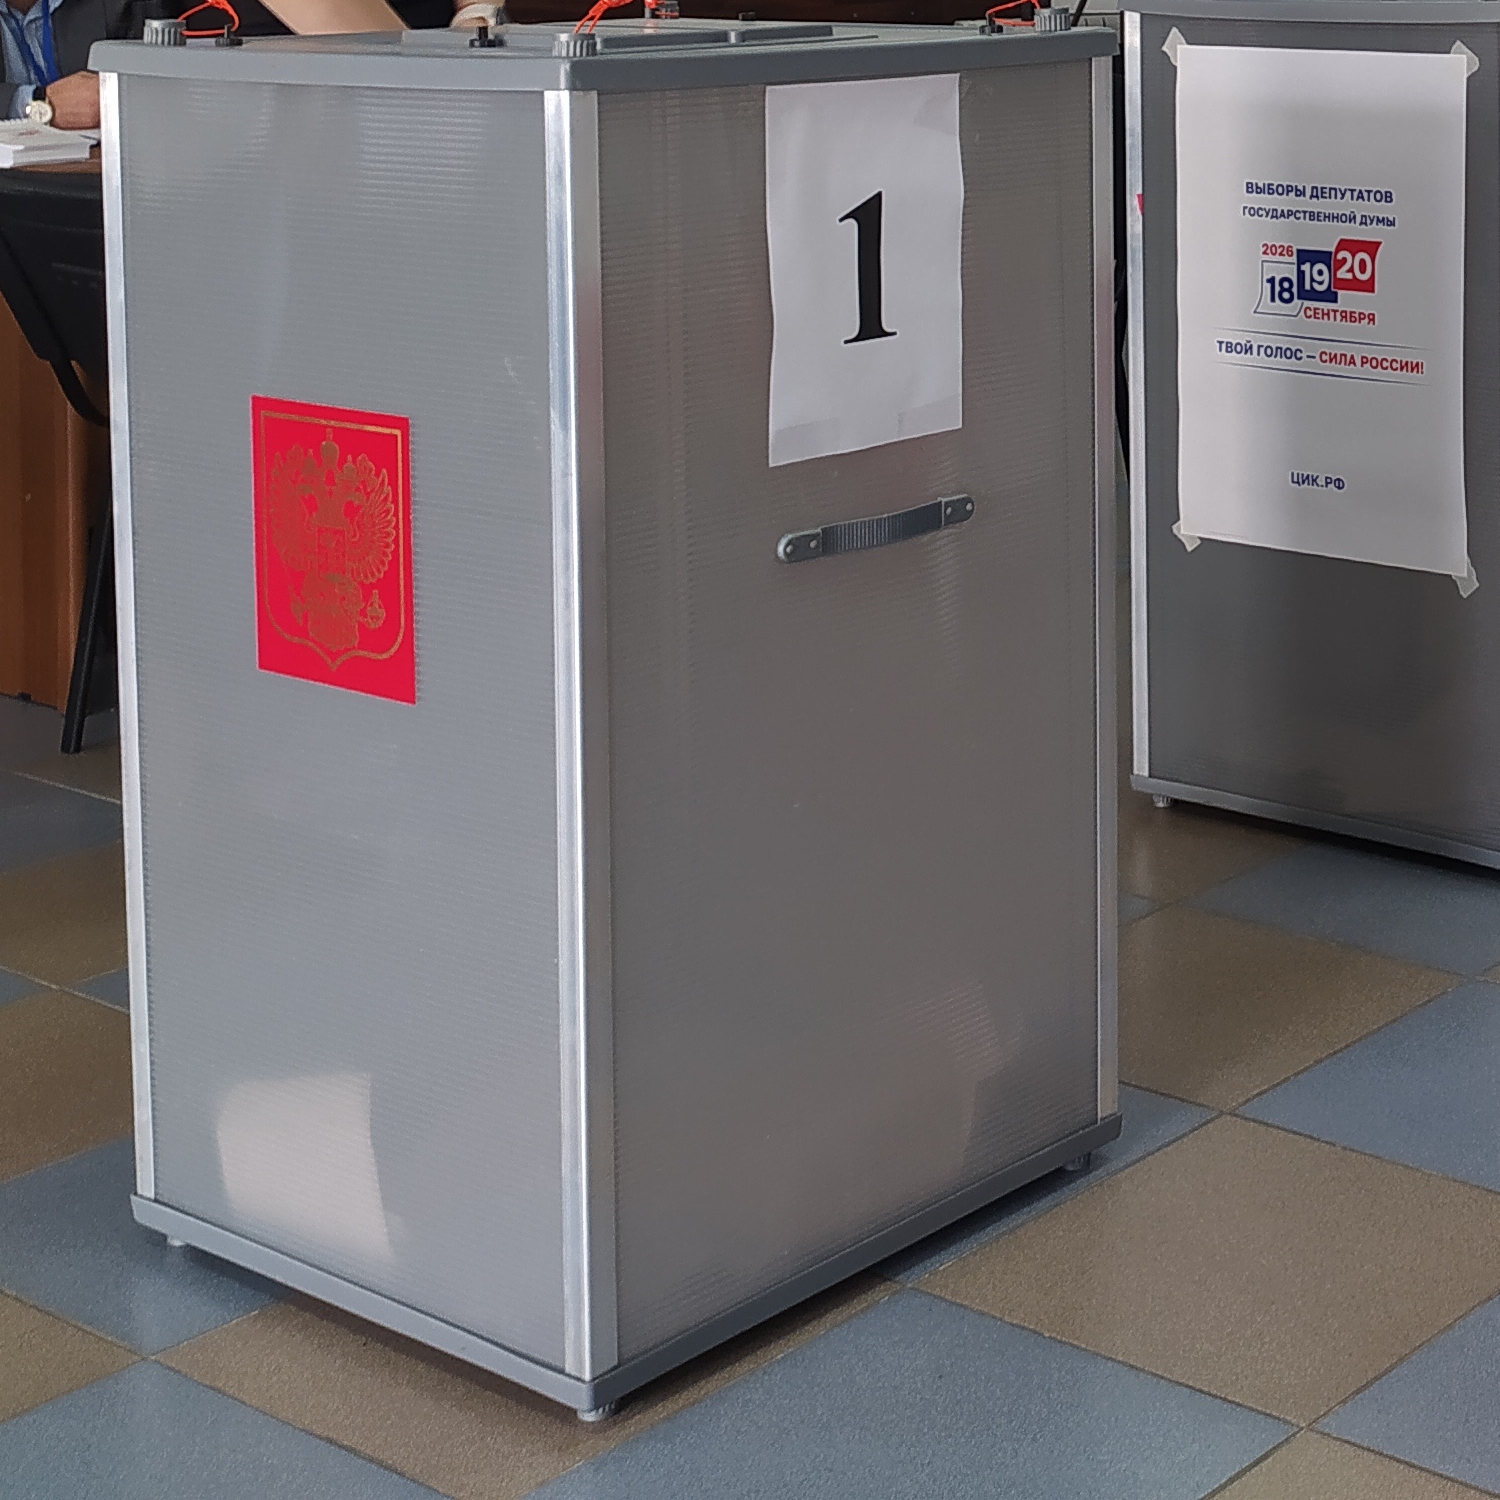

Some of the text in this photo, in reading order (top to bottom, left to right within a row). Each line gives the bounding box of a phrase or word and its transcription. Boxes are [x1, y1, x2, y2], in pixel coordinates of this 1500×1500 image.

[1245, 181, 1394, 204] ВЫБОРЫ ДЕПУТАТОВ
[1242, 205, 1396, 228] ГОСУДАРСТВЕННОЙ ДУМЫ
[1261, 243, 1294, 257] 2026
[838, 190, 897, 344] 1
[1265, 250, 1373, 304] 18 19 20
[1303, 306, 1376, 326] СЕНТЯБРЯ
[1216, 339, 1254, 356] ТВОЙ
[1256, 344, 1304, 361] ГОЛОС
[1318, 350, 1357, 368] СИЛА
[1360, 355, 1425, 375] РОССИИ!
[1290, 471, 1345, 490] ЦИК.РФ
